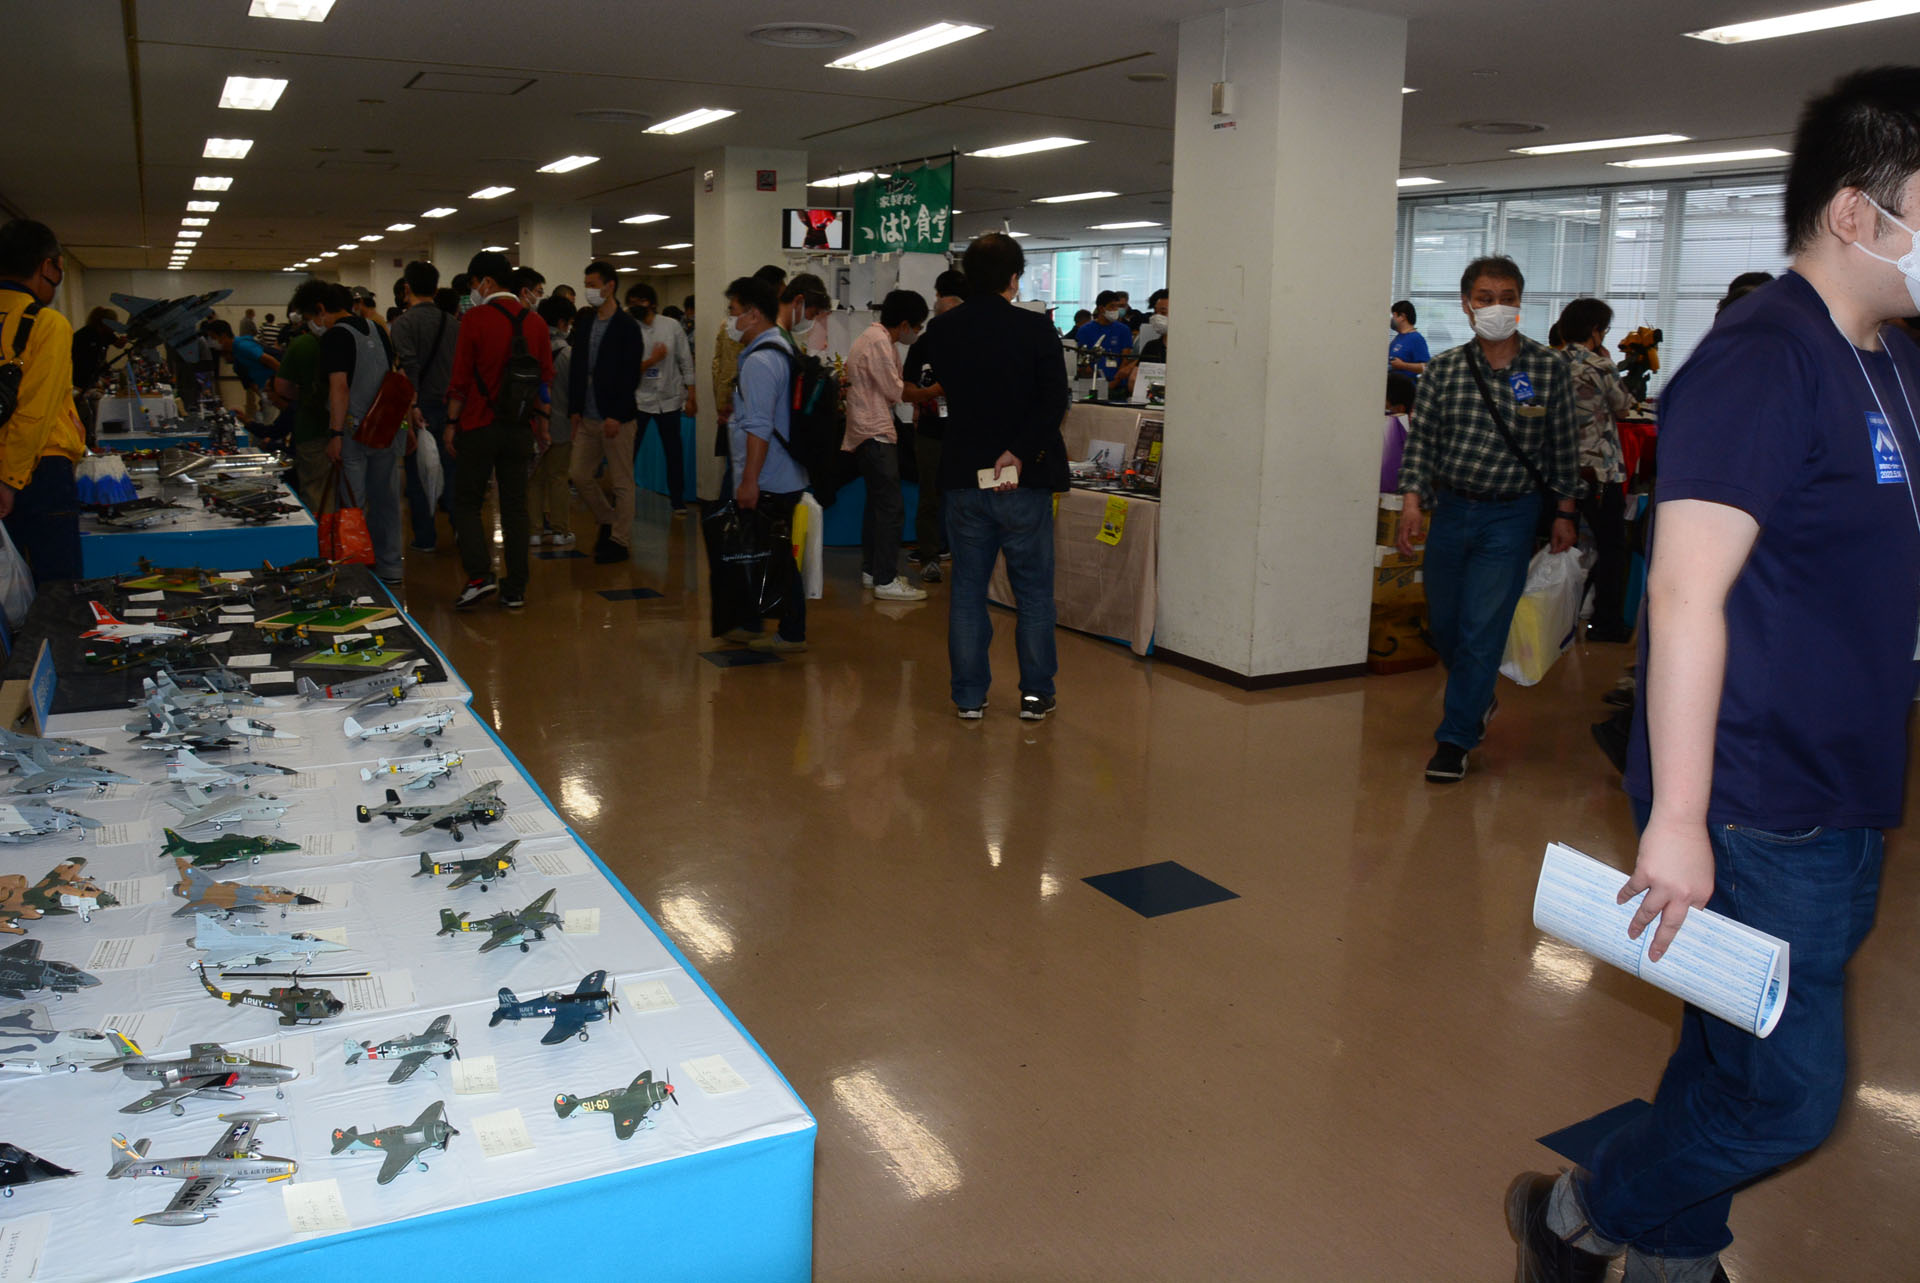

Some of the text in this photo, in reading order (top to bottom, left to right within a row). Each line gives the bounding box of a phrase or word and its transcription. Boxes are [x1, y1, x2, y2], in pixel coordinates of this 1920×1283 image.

[242, 996, 264, 1008] ARMY
[581, 1098, 610, 1112] SU-60
[178, 1176, 217, 1206] USAF
